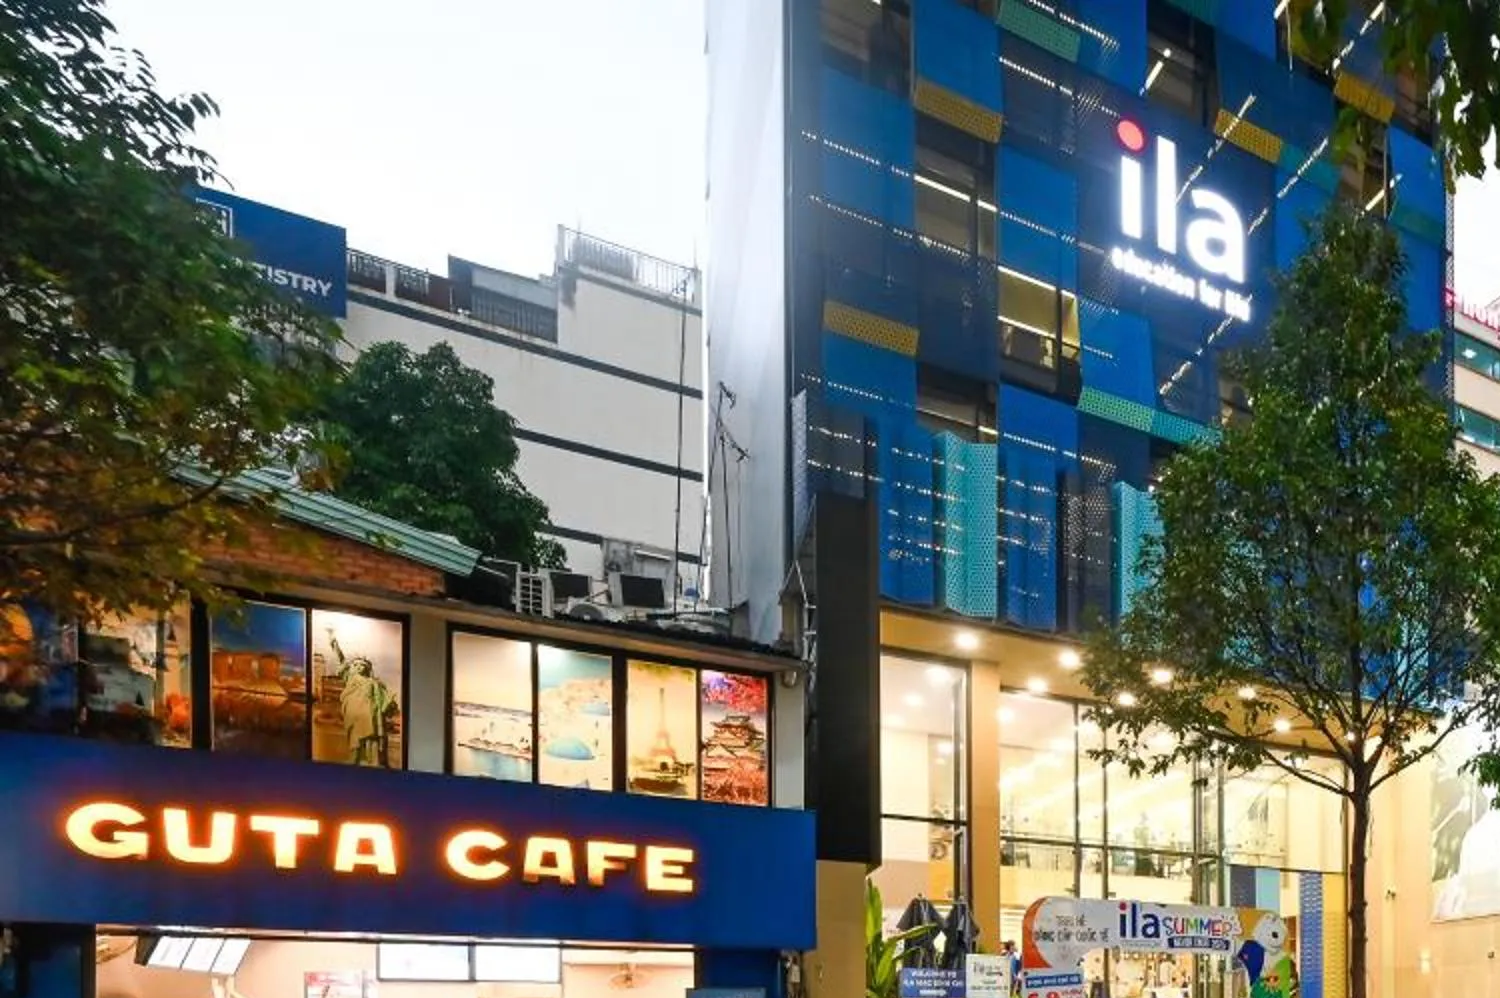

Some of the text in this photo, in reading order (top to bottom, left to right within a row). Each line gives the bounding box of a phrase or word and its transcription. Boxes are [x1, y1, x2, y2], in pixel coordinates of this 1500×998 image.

[1116, 119, 1245, 284] ila
[65, 802, 695, 892] GUTA CAFE
[1119, 901, 1160, 938] ila
